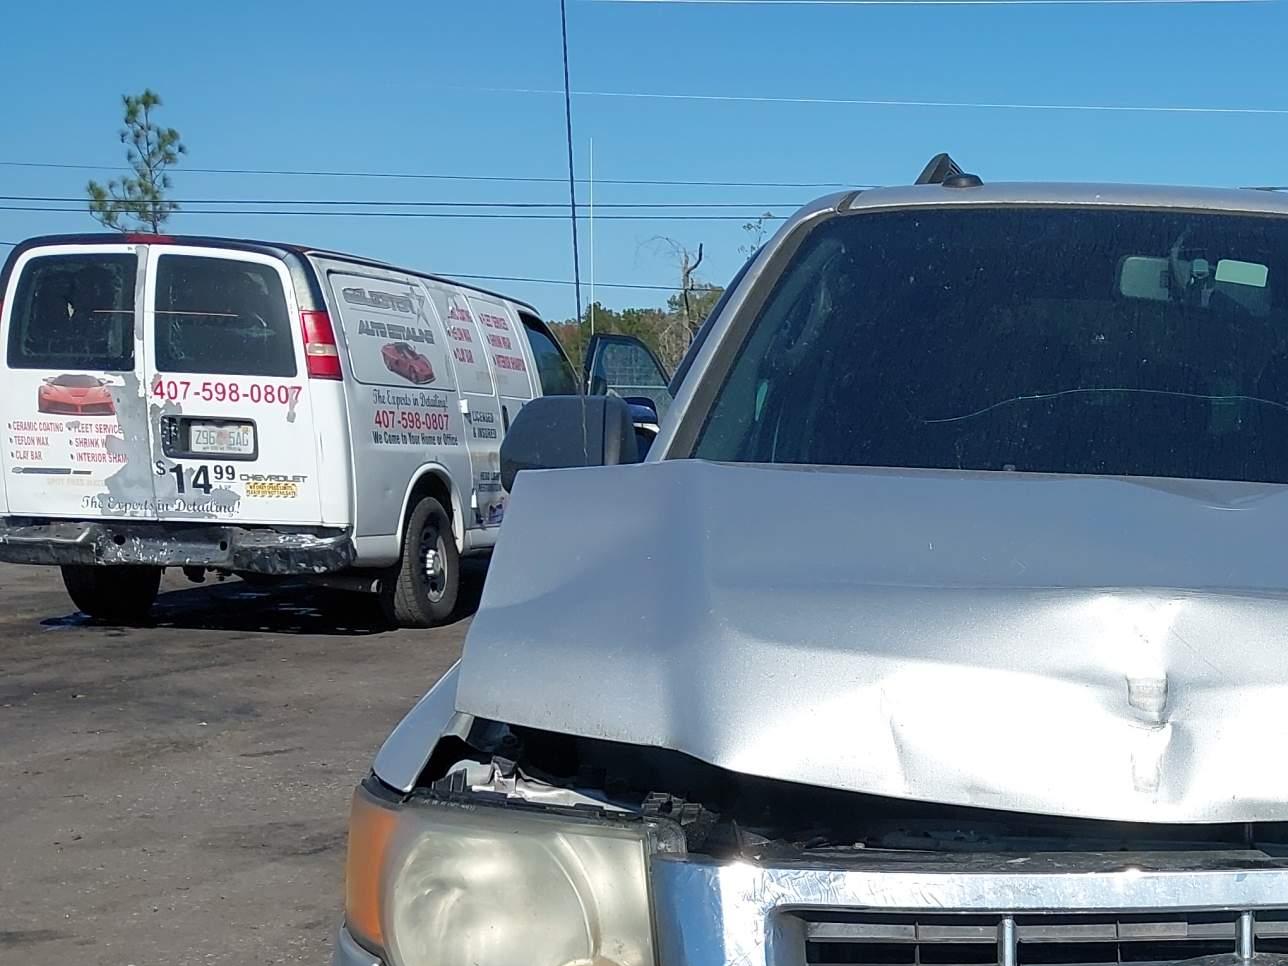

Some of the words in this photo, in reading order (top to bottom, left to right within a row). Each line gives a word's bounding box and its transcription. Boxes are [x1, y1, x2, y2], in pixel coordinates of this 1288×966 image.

[153, 380, 303, 405] 407-598-0807
[373, 388, 386, 405] The
[386, 389, 411, 411] Experts
[12, 420, 38, 432] CERAMIC
[38, 421, 64, 433] COATING
[374, 410, 449, 430] 407-598-0807
[14, 435, 36, 446] TEFLON
[36, 436, 50, 447] WAX
[75, 437, 99, 448] SHRINK
[372, 431, 383, 445] We
[15, 450, 30, 460] CLAY
[31, 451, 43, 461] BAR
[77, 452, 106, 463] INTERIOR
[240, 474, 308, 483] CHEVROLET
[80, 495, 104, 510] The
[107, 495, 154, 514] Experts
[157, 500, 169, 511] in
[174, 498, 241, 517] Detailing!
